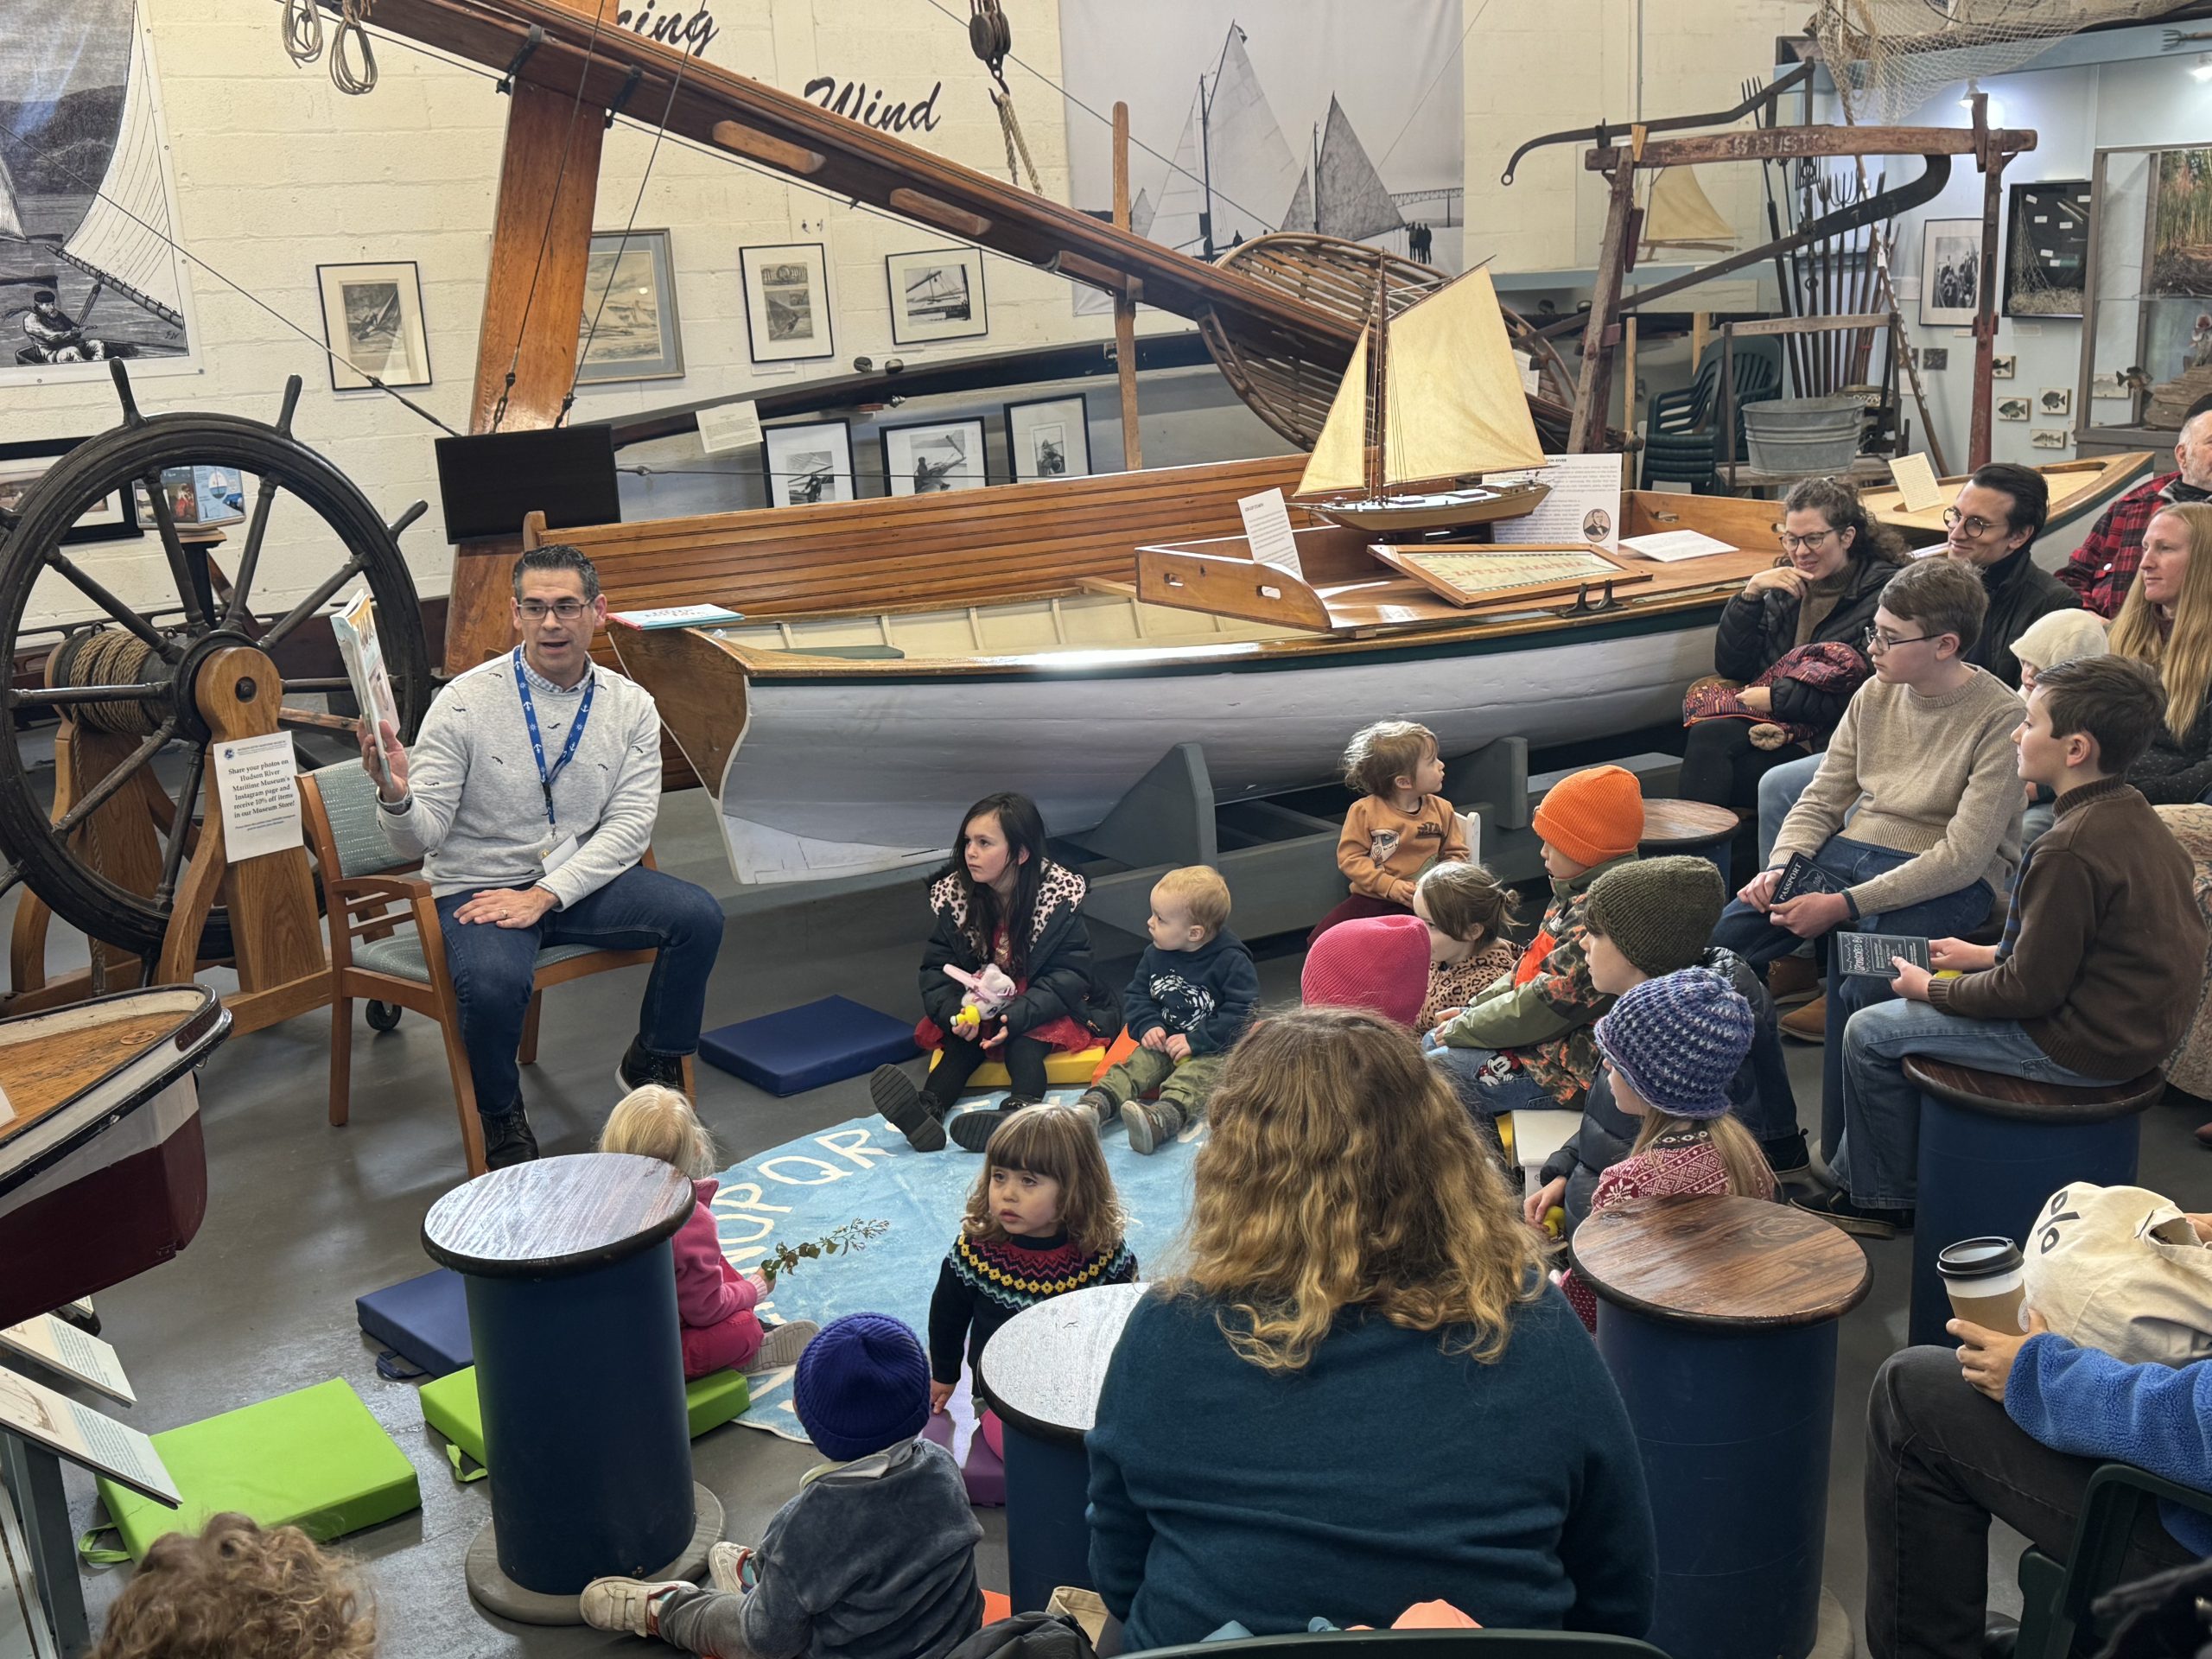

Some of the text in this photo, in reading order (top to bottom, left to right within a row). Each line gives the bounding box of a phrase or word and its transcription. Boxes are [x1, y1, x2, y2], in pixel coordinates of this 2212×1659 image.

[804, 76, 942, 132] Wind
[1453, 567, 1515, 576] LITTLE
[246, 765, 259, 773] your
[260, 761, 280, 770] photos
[232, 775, 290, 791] Maritime Museum's
[240, 772, 264, 782] Hudson
[235, 791, 264, 801] Instagram
[264, 787, 279, 796] page
[234, 801, 254, 810] receive
[252, 804, 277, 814] Museum
[278, 800, 295, 809] Store!
[1778, 862, 1802, 900] PASSPORT
[1852, 935, 1866, 971] SPONSORED BY
